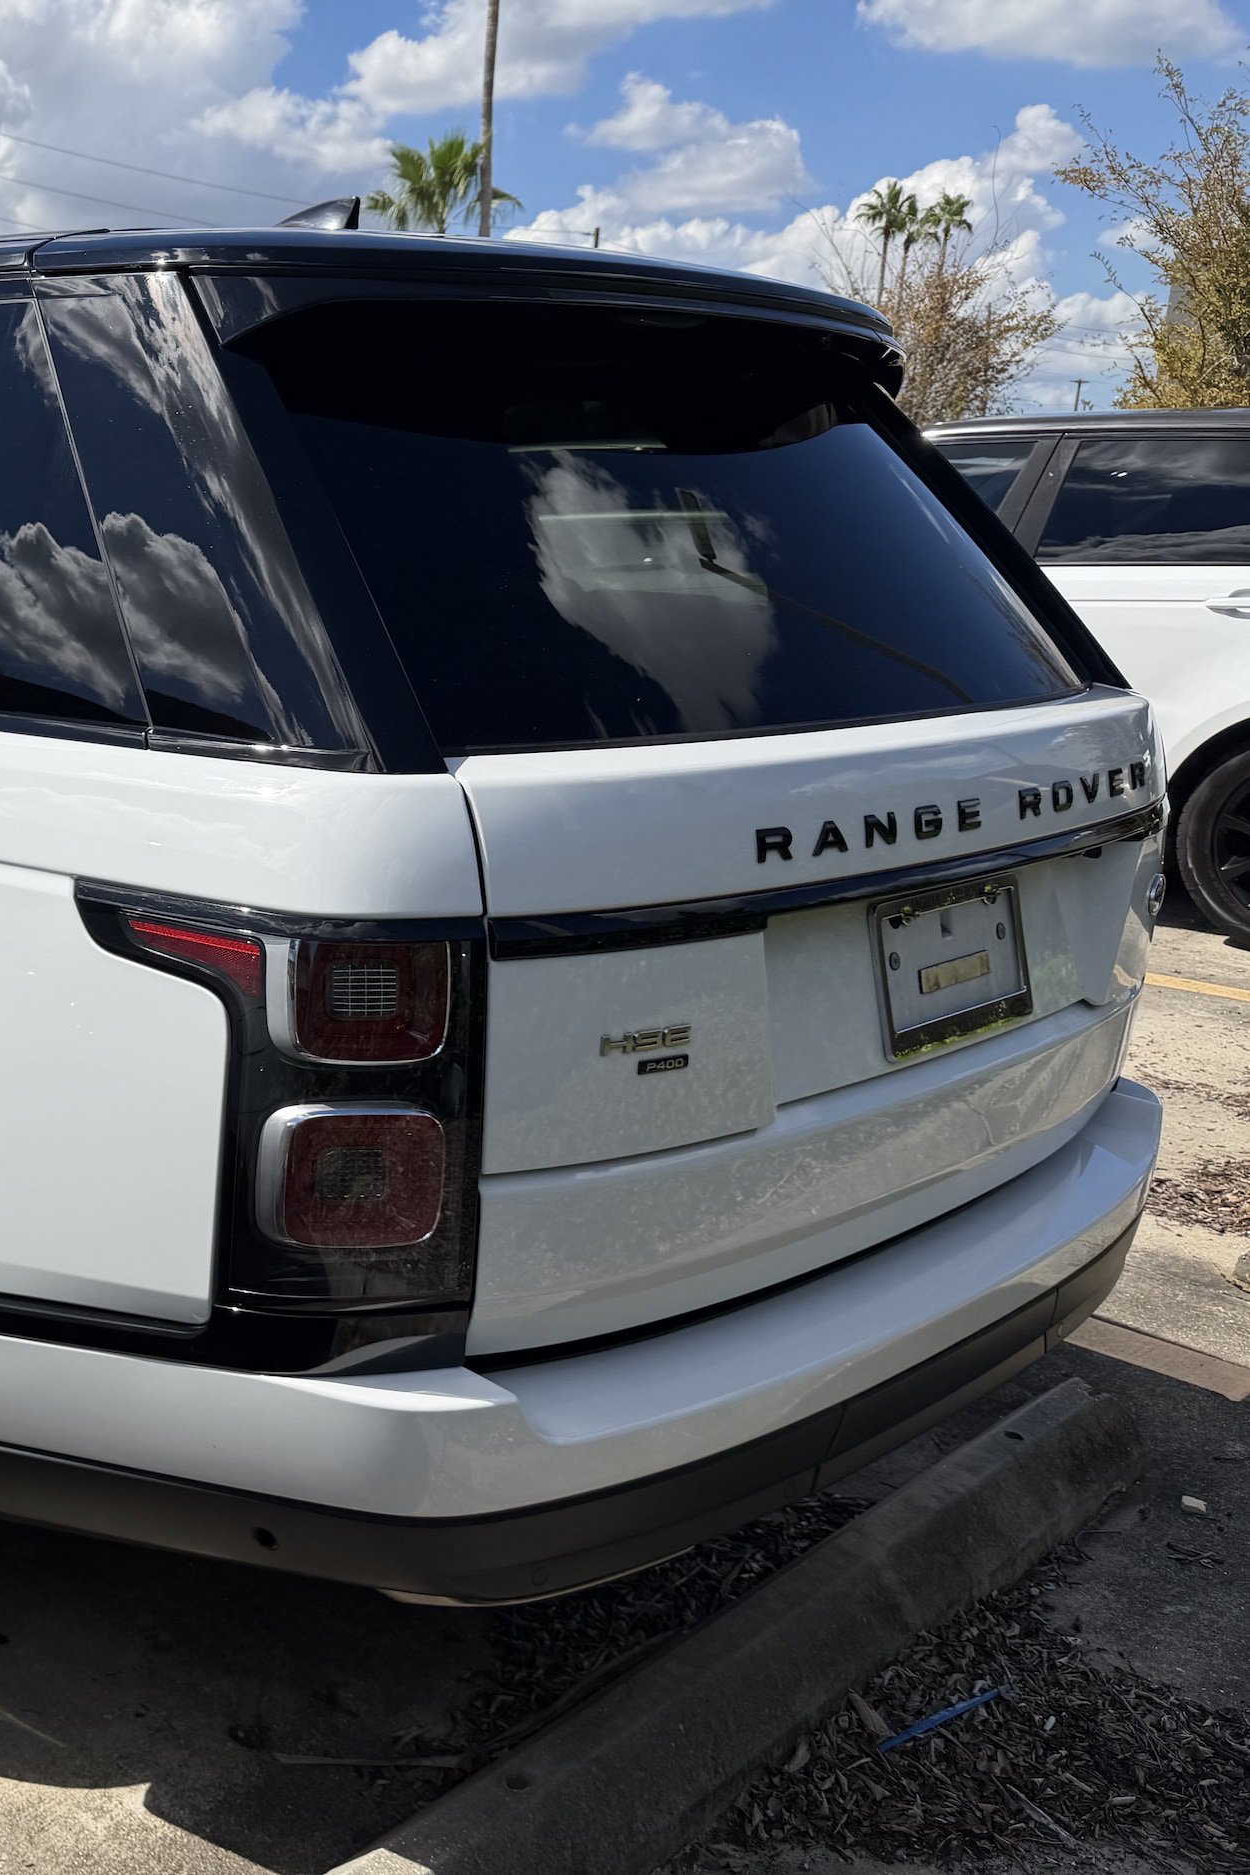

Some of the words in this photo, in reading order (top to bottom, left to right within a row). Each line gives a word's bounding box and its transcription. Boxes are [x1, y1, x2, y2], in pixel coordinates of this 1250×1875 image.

[754, 797, 982, 864] RANGE
[1017, 760, 1148, 821] ROVER
[599, 1022, 691, 1057] HSE
[645, 1057, 686, 1073] P400
